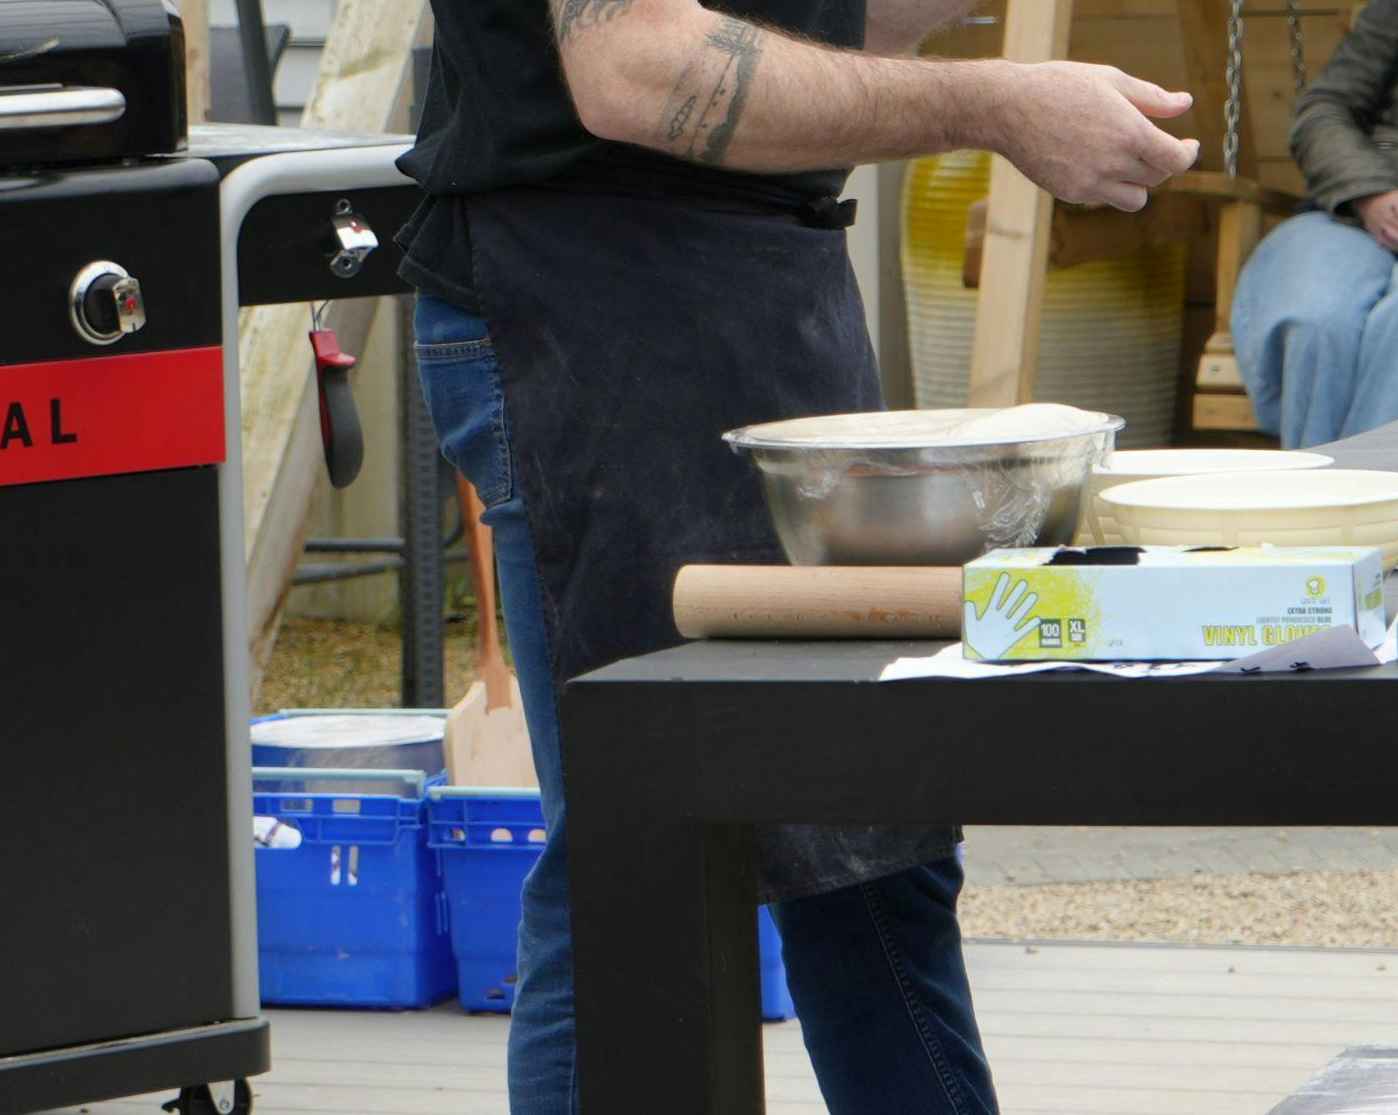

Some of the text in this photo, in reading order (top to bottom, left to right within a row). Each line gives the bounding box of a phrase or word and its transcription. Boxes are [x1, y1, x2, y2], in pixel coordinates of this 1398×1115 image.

[1040, 623, 1060, 637] 100
[1069, 620, 1085, 633] XL
[1202, 625, 1258, 646] VINYL
